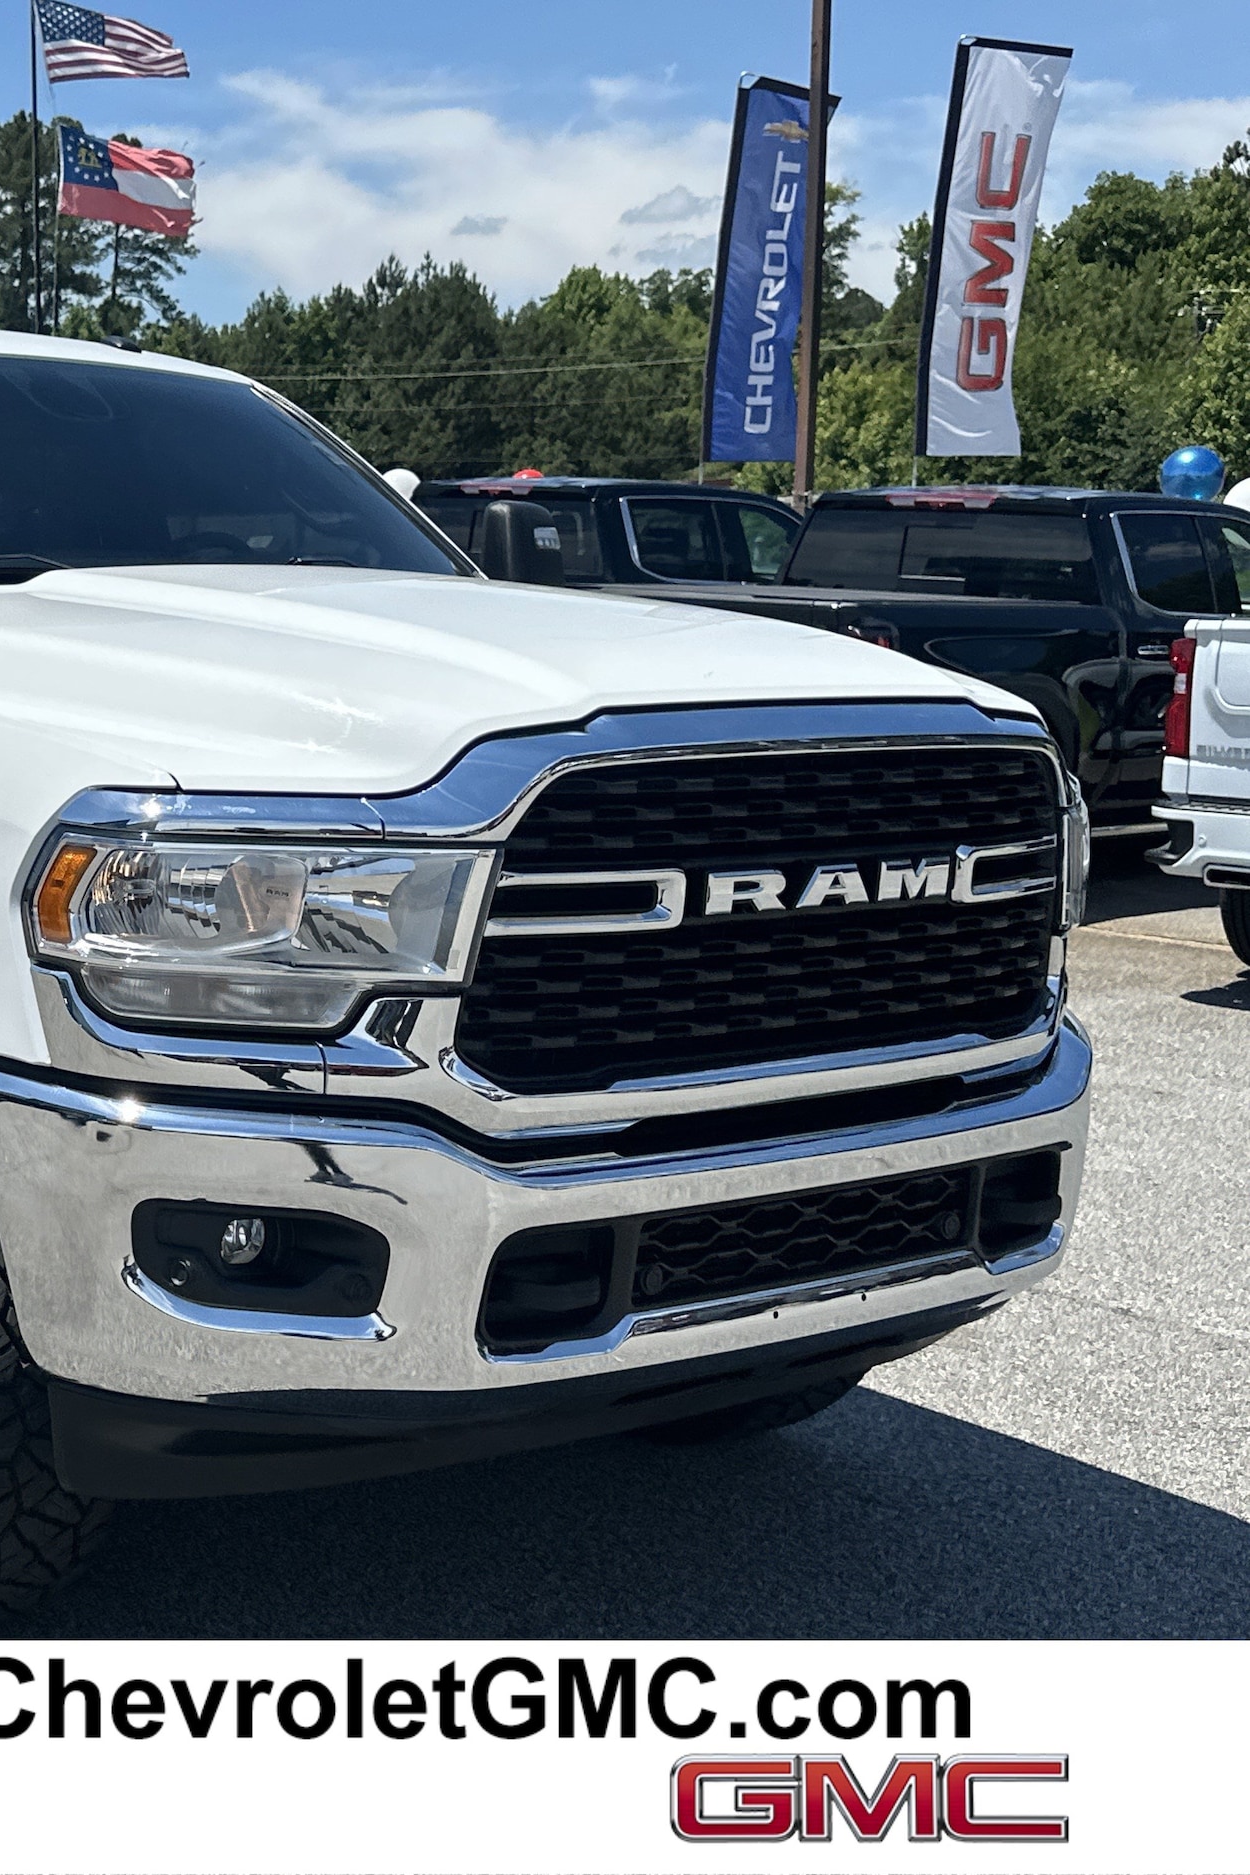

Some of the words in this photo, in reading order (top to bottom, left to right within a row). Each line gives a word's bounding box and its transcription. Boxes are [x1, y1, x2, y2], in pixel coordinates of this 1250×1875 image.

[744, 150, 803, 435] CHEVROLET
[957, 131, 1032, 392] GMC
[705, 856, 951, 916] RAM
